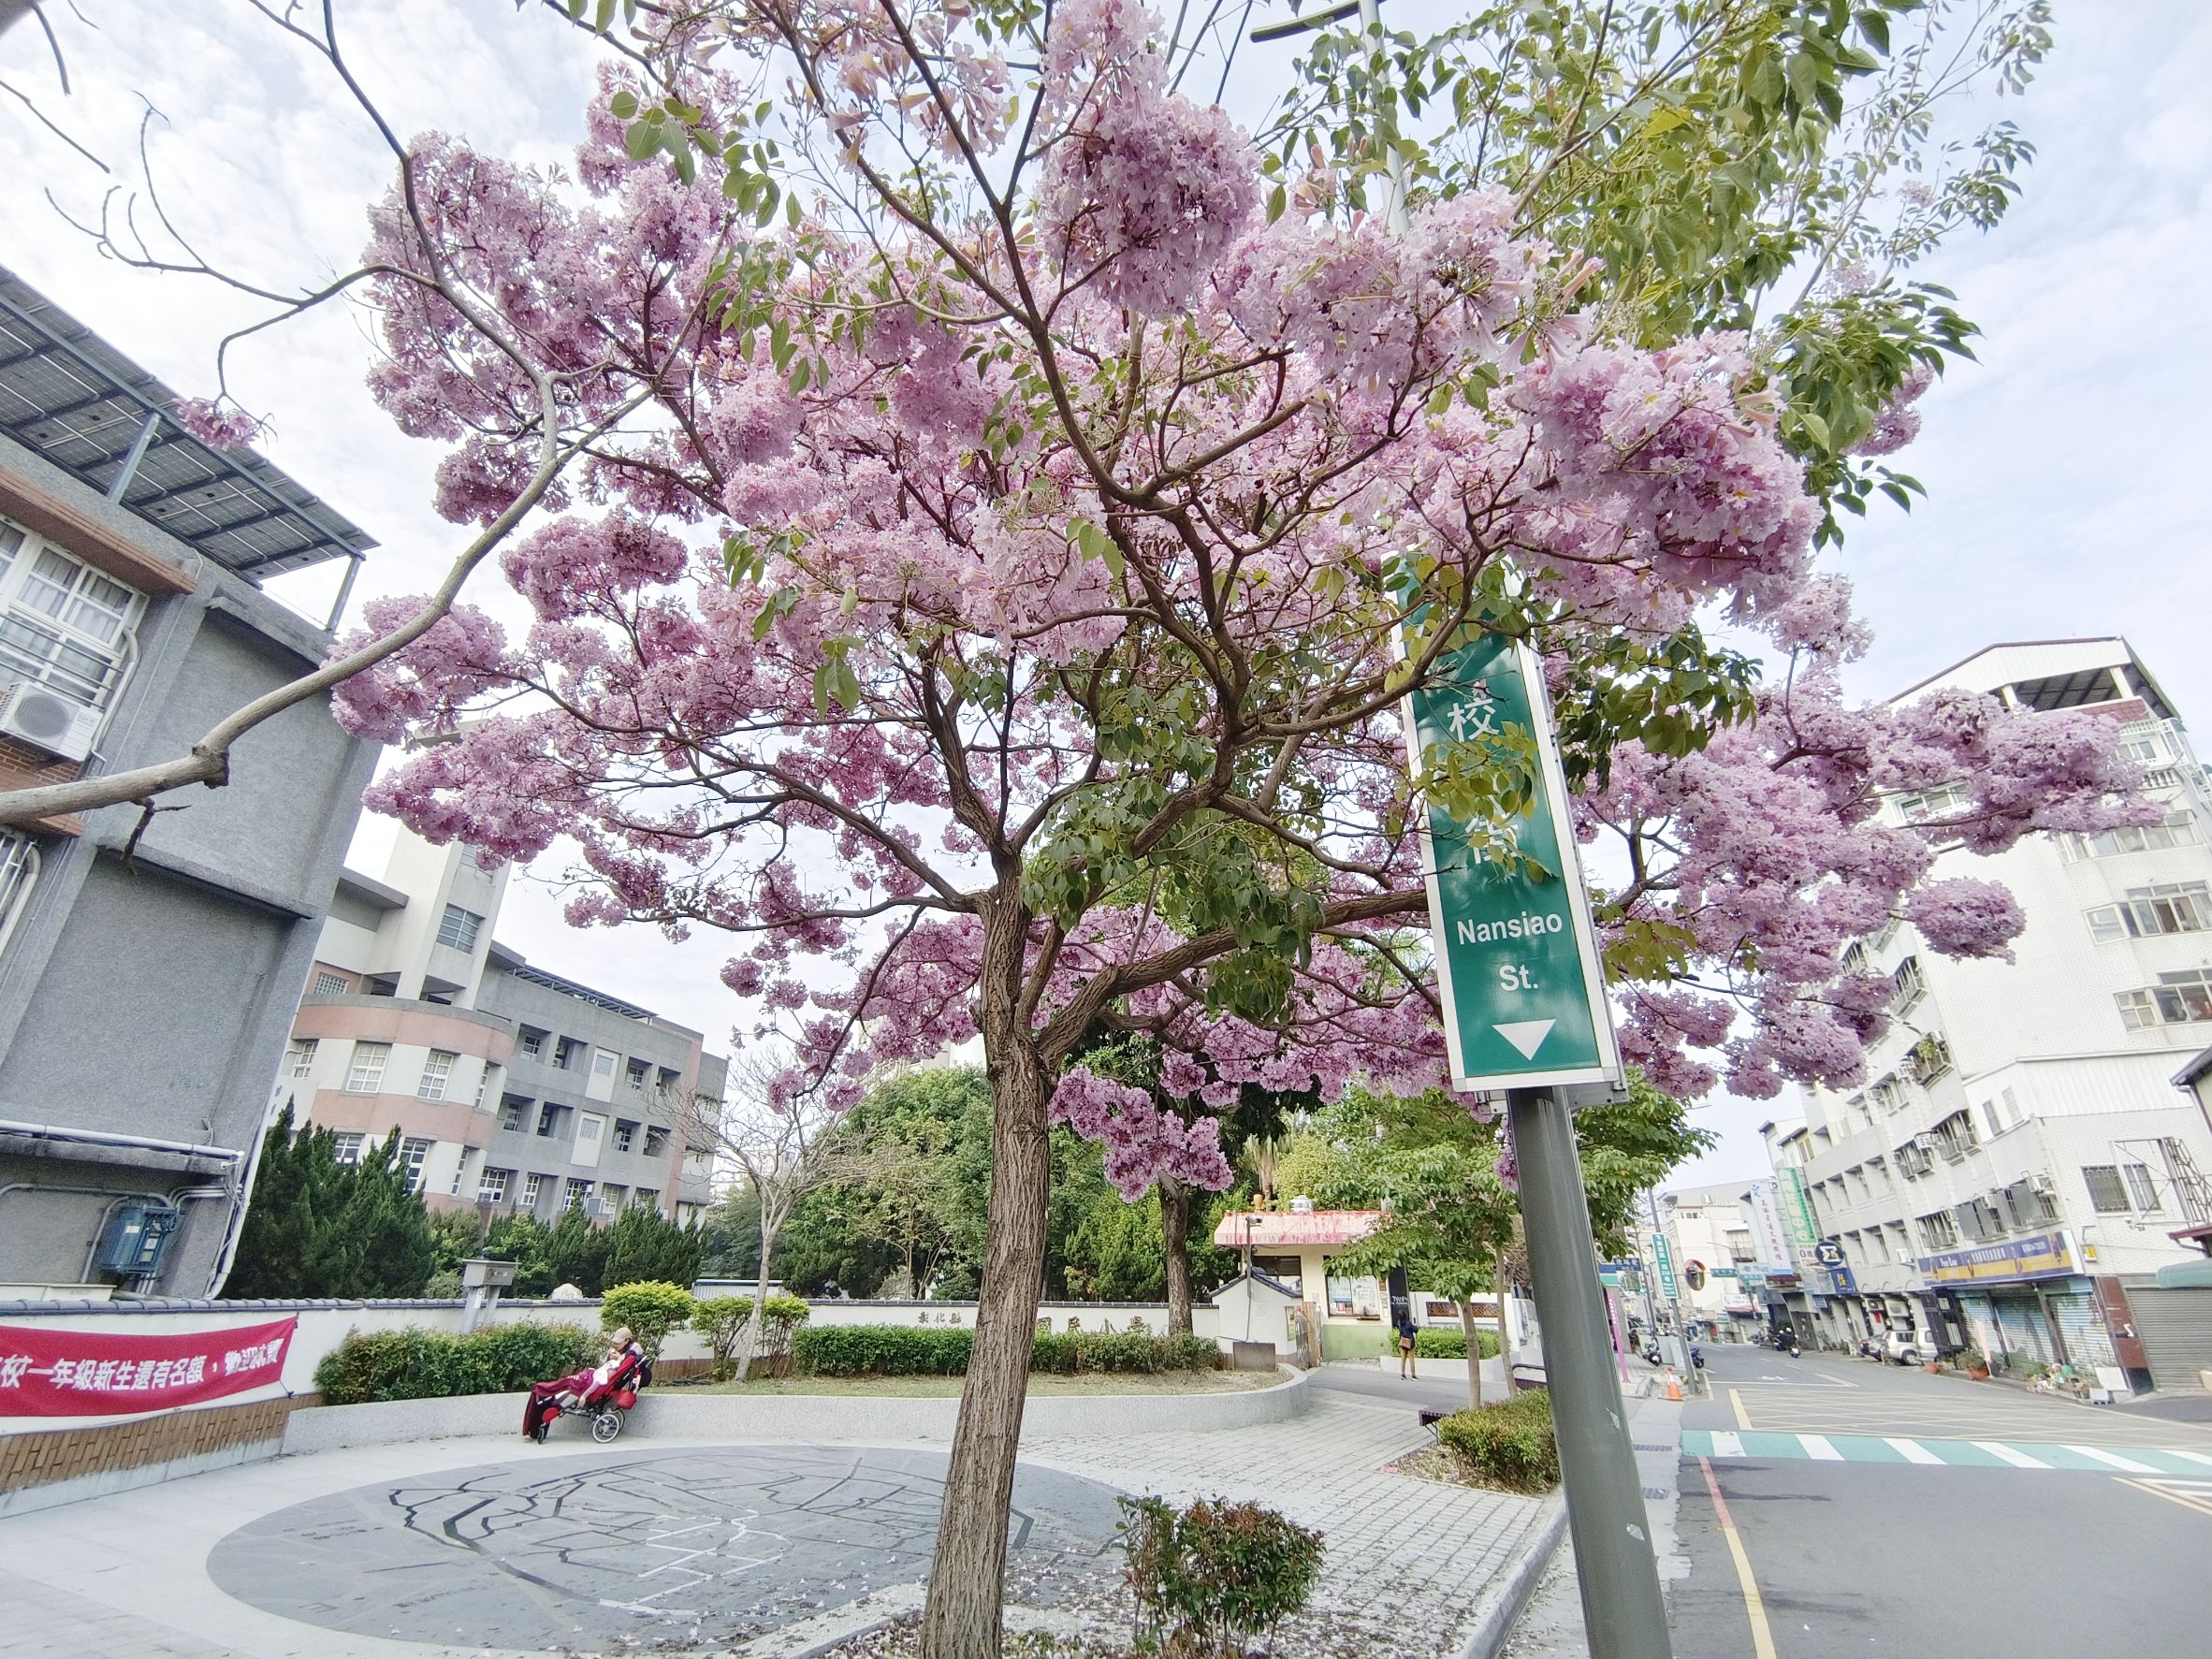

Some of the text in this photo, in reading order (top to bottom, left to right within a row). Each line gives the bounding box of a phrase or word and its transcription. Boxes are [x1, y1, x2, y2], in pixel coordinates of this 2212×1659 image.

[1456, 910, 1563, 945] Nansiao
[1499, 964, 1539, 992] St.
[917, 1311, 962, 1324] 彰化縣
